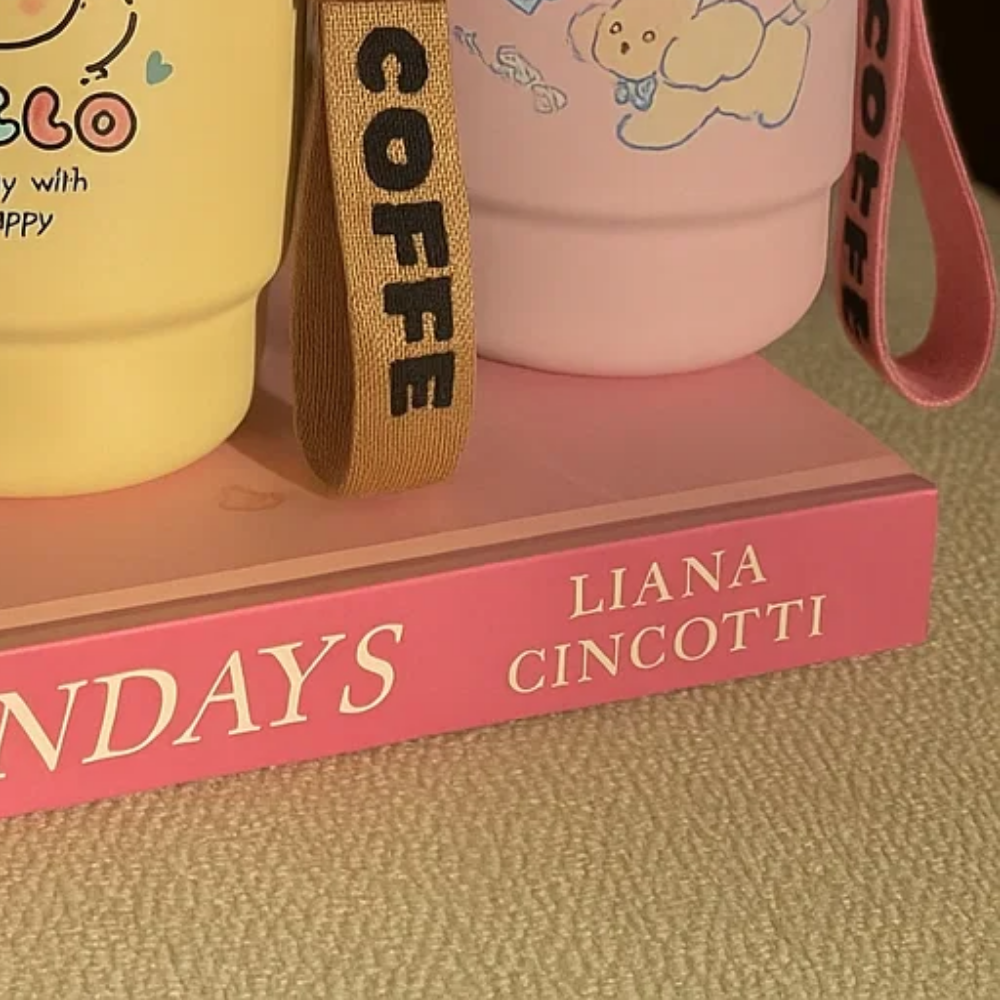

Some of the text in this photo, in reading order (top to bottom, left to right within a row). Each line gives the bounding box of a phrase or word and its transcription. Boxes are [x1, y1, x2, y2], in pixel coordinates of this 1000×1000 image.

[30, 166, 88, 193] with
[356, 26, 456, 418] COFFE
[568, 544, 768, 620] LIANA
[507, 594, 827, 694] CINCOTTI
